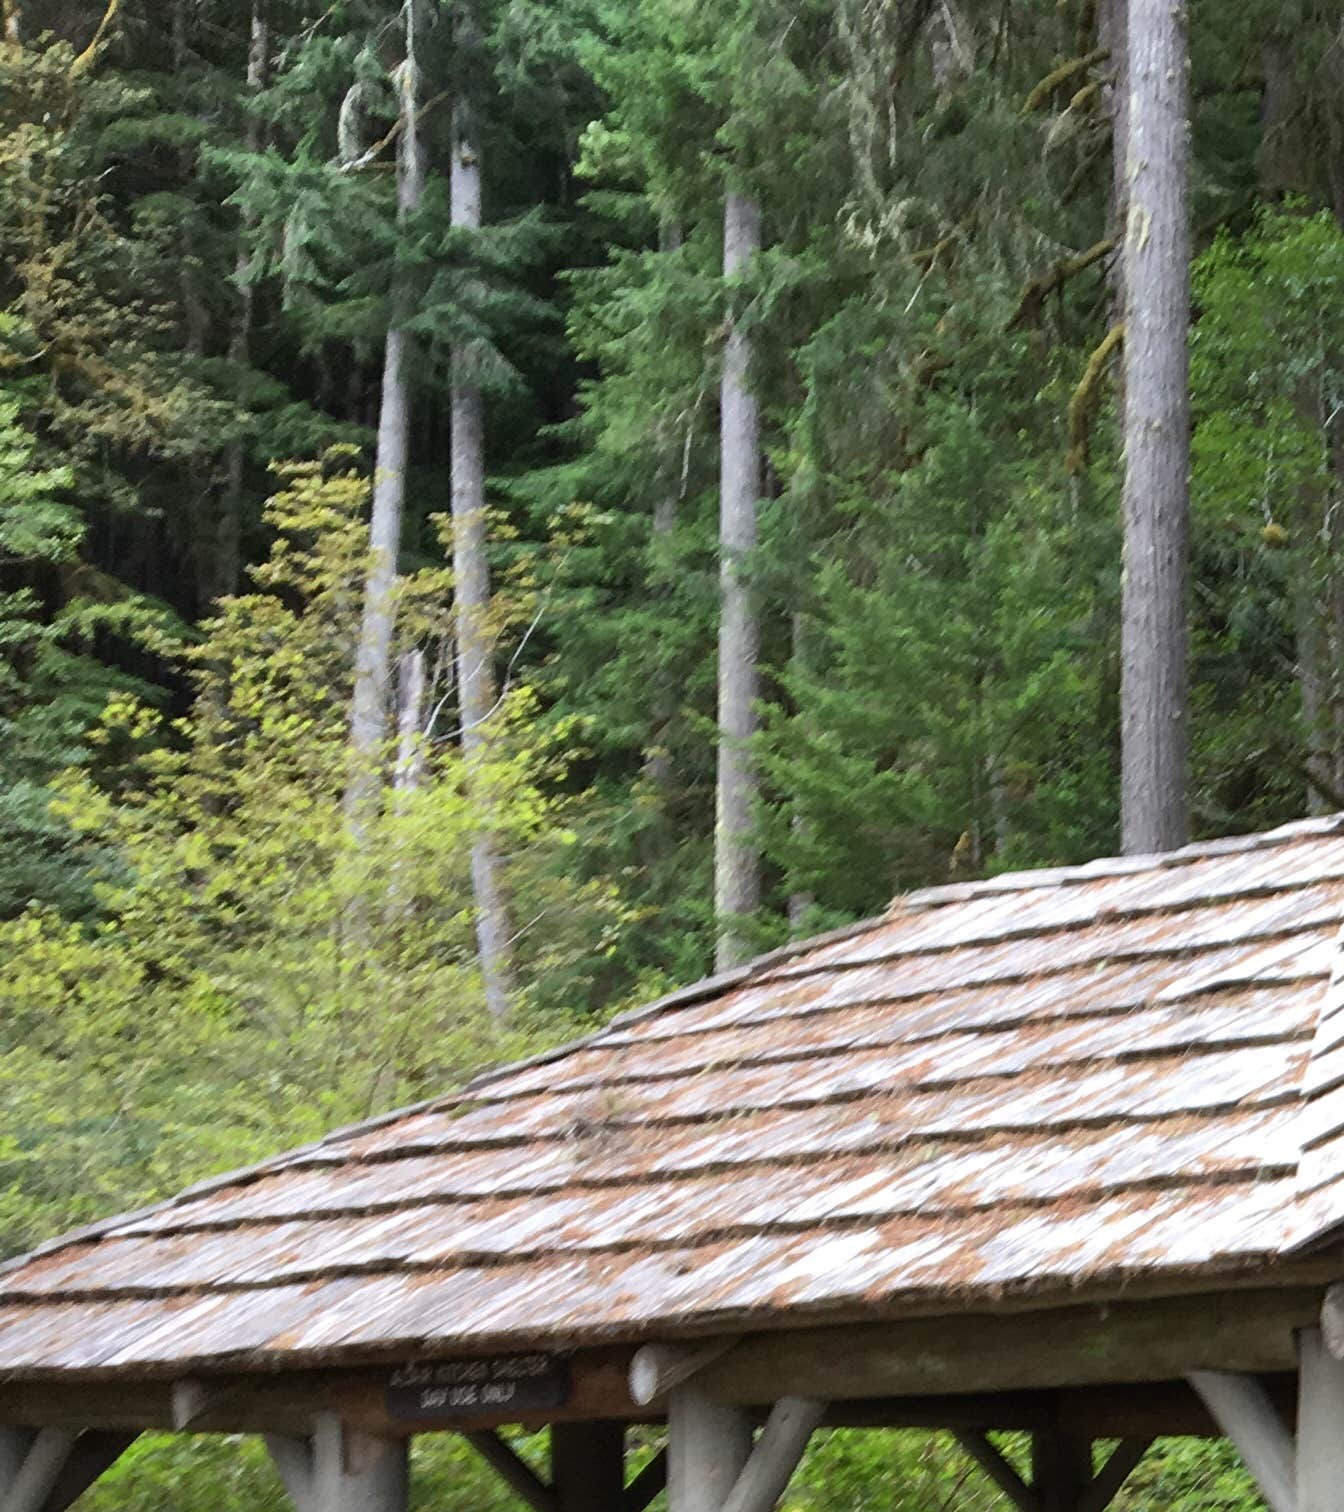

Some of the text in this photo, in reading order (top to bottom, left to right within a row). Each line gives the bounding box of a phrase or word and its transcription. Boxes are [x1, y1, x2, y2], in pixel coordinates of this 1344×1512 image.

[420, 1382, 516, 1408] DAY USE ONLY
